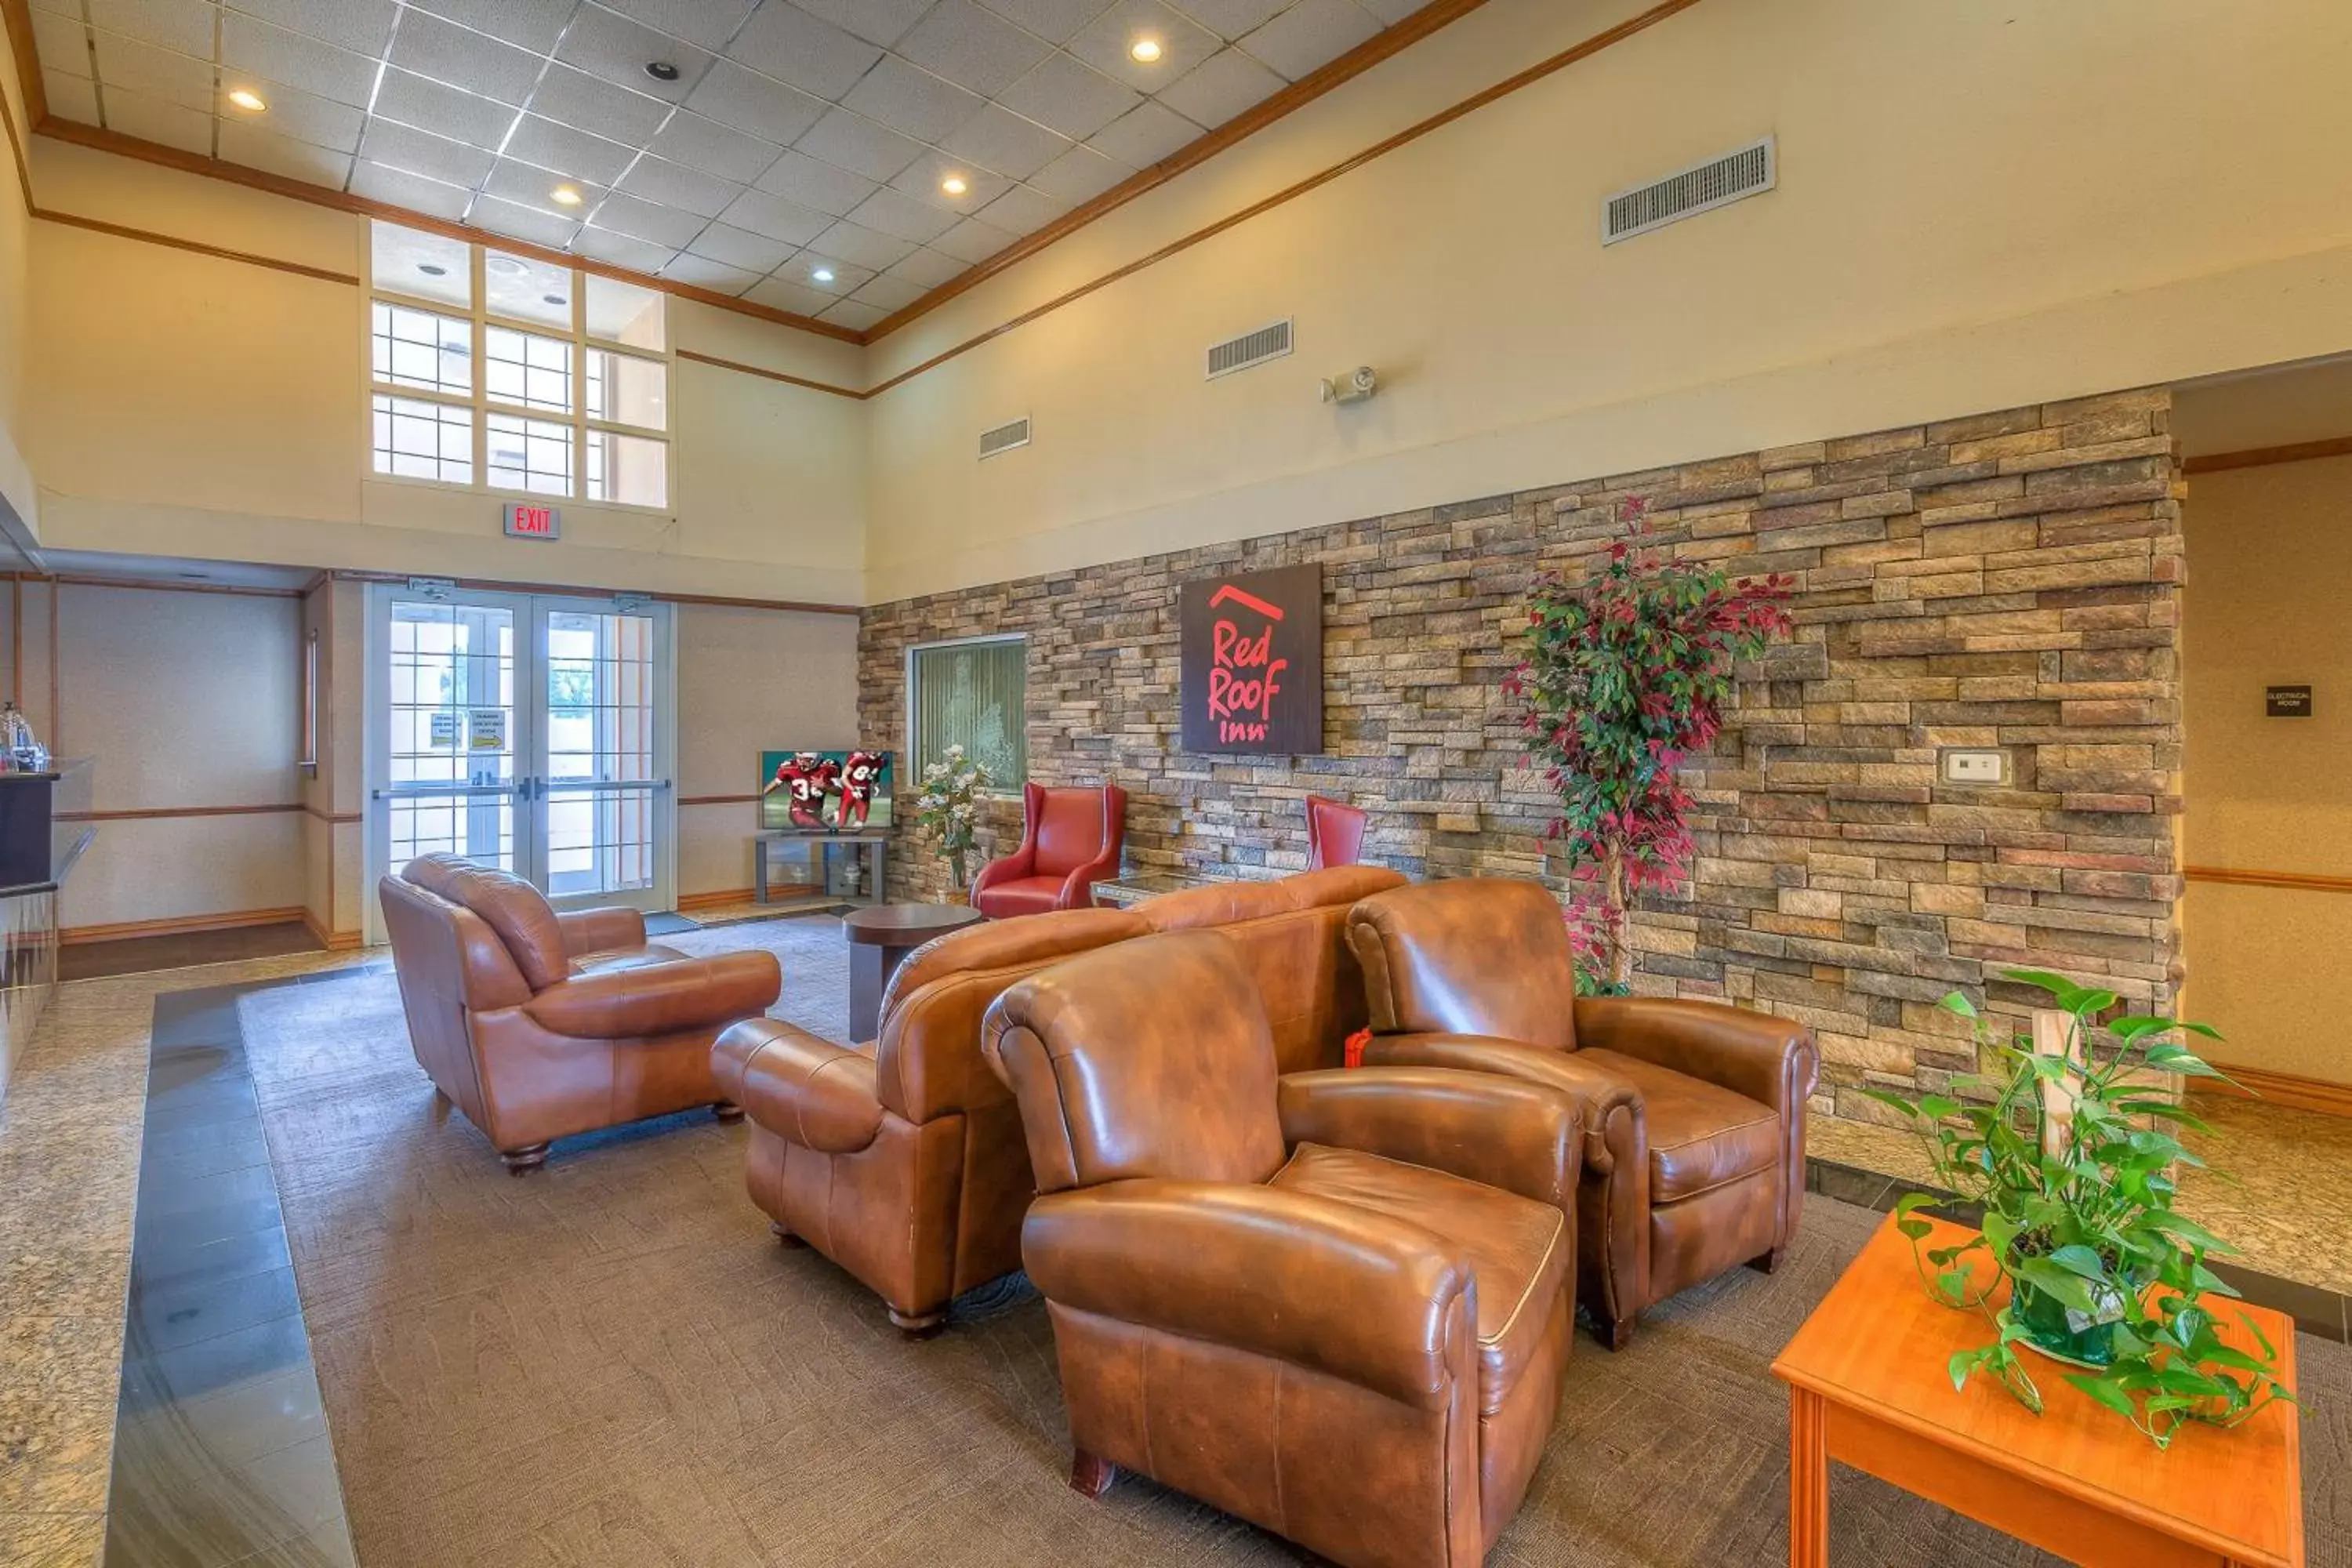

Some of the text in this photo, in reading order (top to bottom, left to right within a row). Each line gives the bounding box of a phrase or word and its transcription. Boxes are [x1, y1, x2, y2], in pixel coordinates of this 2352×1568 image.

[515, 506, 551, 534] EXIT
[1213, 619, 1272, 669] Red
[1207, 659, 1288, 720] Roof
